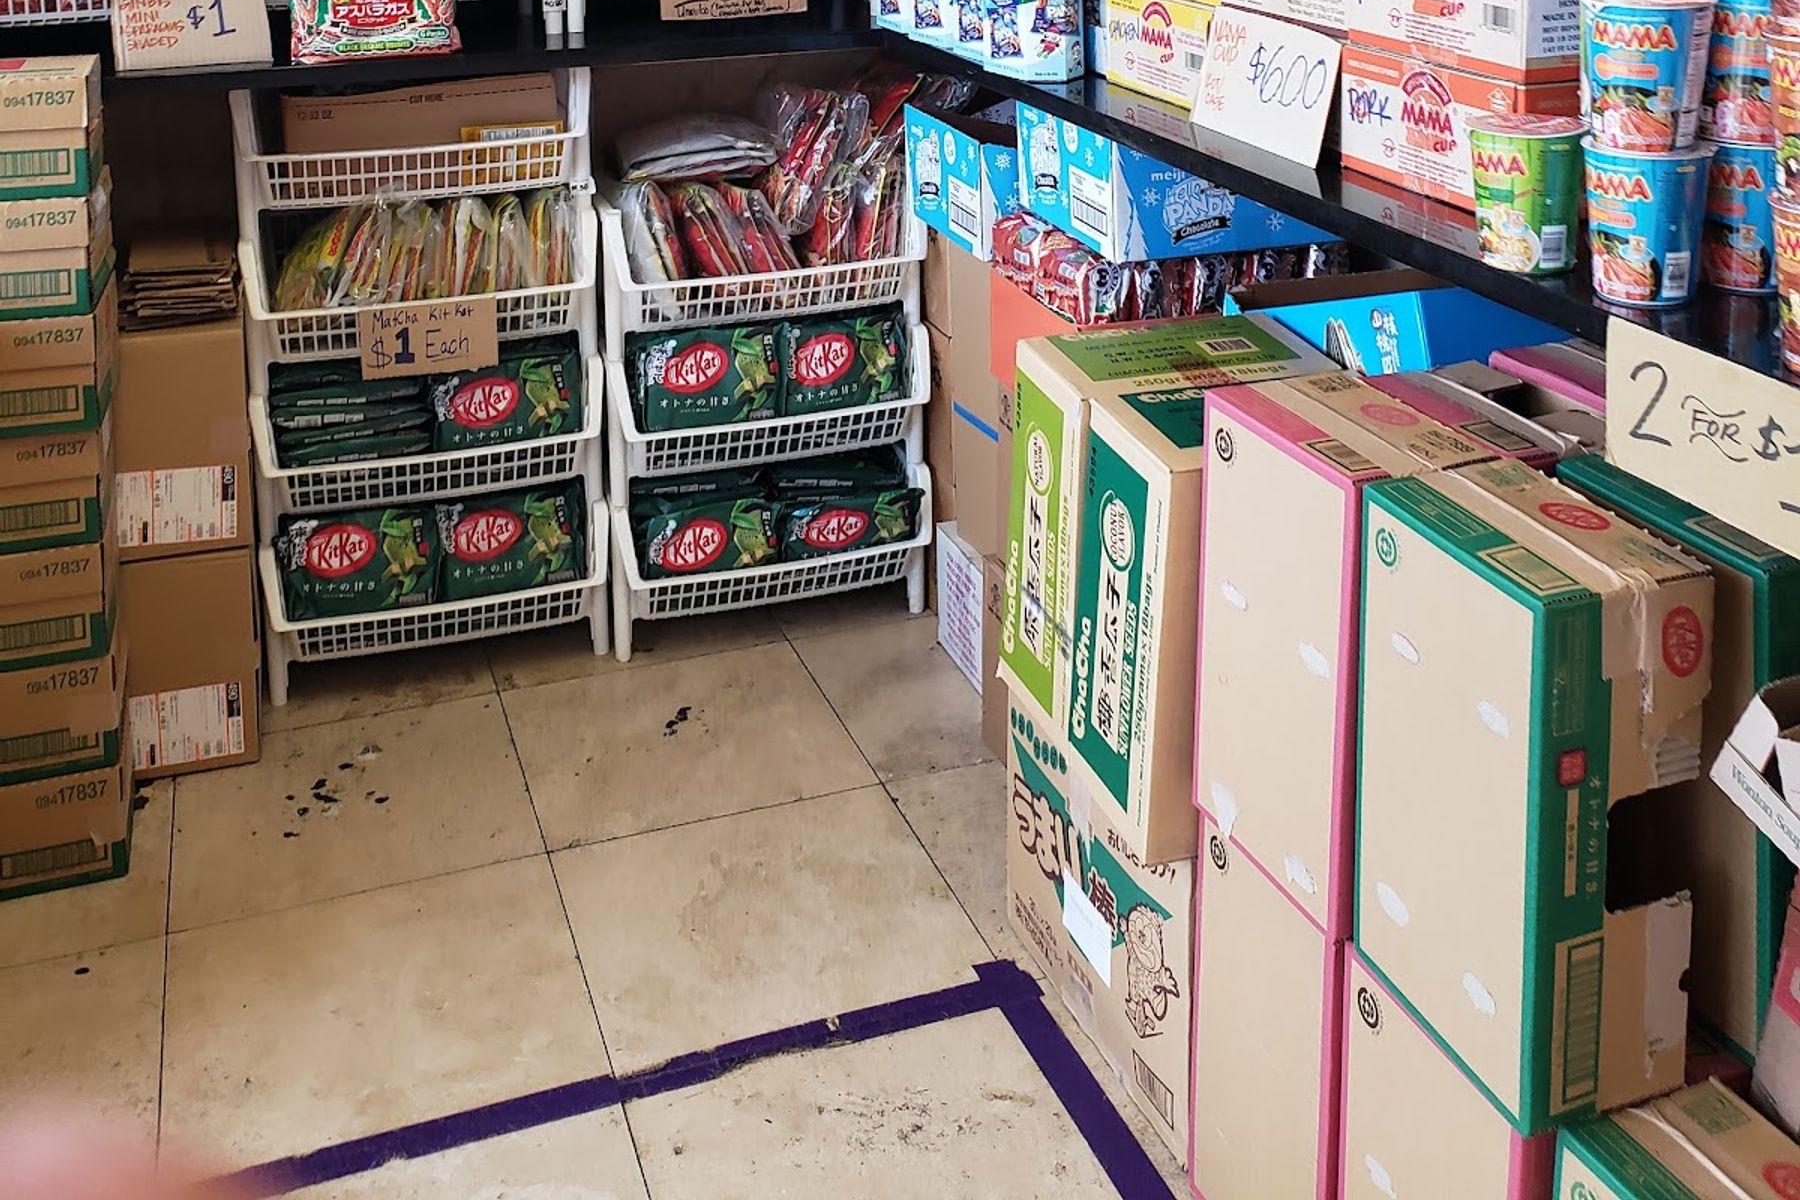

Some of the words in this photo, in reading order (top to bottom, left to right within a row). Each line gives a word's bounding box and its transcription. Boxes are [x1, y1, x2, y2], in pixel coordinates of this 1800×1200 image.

[125, 10, 161, 23] MINI
[335, 3, 411, 18] アスパラガス
[1439, 2, 1465, 18] CUP
[1541, 12, 1566, 23] MADE
[338, 43, 359, 53] BLACK
[1140, 27, 1174, 51] MAMA
[1592, 19, 1679, 51] MAMA
[1159, 51, 1175, 64] CUP
[3, 90, 76, 109] 09417837
[1347, 86, 1395, 128] PORK
[1401, 100, 1454, 137] MAMA
[1433, 138, 1458, 155] CUP
[1473, 149, 1527, 177] AMA
[5, 210, 78, 230] 09417837
[1165, 192, 1236, 227] PANDA
[1180, 218, 1221, 238] Chocolate
[429, 306, 450, 322] Kit
[13, 327, 85, 348] 09417837
[366, 326, 416, 369] $1
[425, 328, 472, 360] Each
[672, 348, 719, 388] KitKat
[802, 340, 849, 379] KitKat
[459, 384, 511, 423] KitKat
[1137, 387, 1207, 405] ChaC
[1629, 360, 1673, 448] 2
[1690, 408, 1743, 446] FOR
[15, 439, 88, 462] 09417837
[1032, 435, 1041, 487] NATURAL
[459, 516, 513, 554] KitKat
[815, 514, 863, 545] KitKat
[1117, 510, 1126, 561] FLAVOR
[312, 531, 367, 569] KitKat
[669, 527, 719, 567] KitKat
[1045, 529, 1057, 578] SEEDS
[19, 558, 92, 582] 09417837
[1002, 538, 1020, 655] ChaCha
[1121, 599, 1138, 657] SEEDS
[1096, 571, 1121, 738] 椰香瓜子
[26, 667, 100, 696] 09417837
[1071, 616, 1092, 740] ChaCha
[1116, 663, 1135, 761] SUNFLOWER
[35, 780, 109, 811] 09417837
